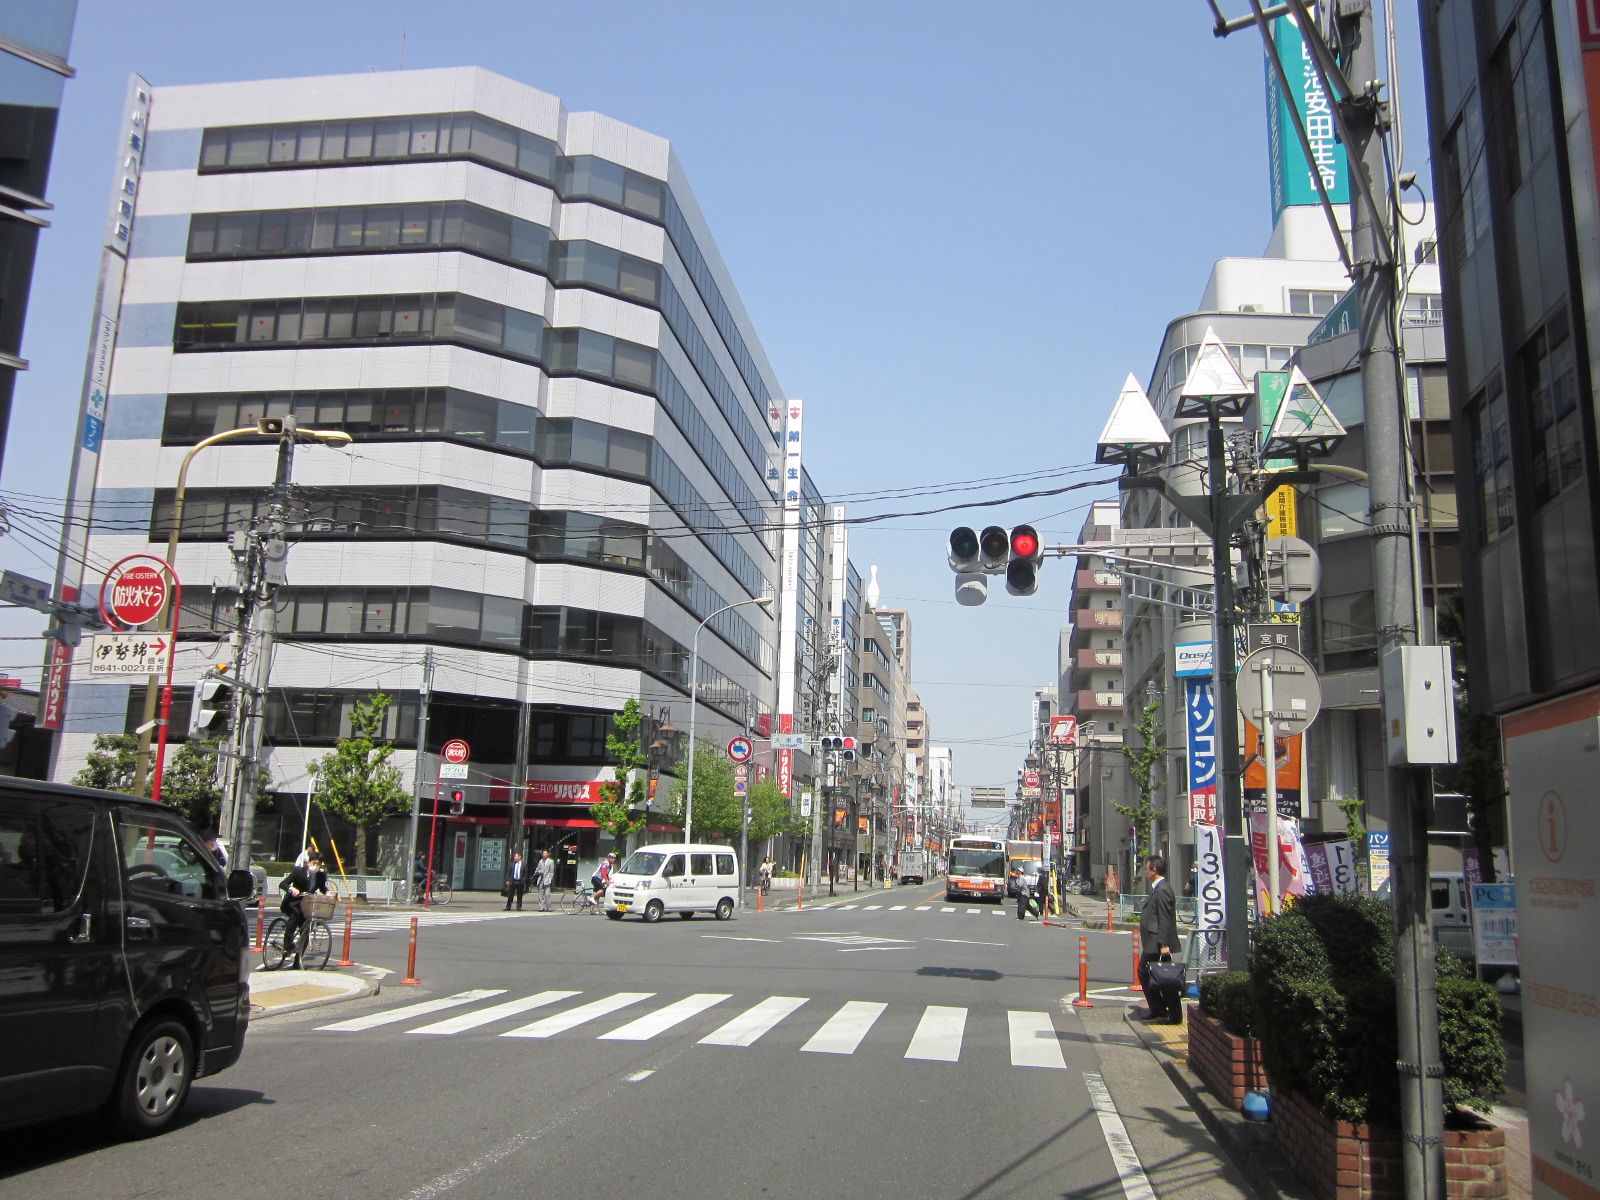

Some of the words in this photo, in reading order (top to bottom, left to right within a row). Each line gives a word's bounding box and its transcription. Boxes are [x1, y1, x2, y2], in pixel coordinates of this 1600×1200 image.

[787, 430, 800, 502] 第一生命
[114, 585, 163, 607] 防火水そう
[1260, 632, 1288, 645] 宮町
[96, 642, 147, 664] 伊勢錦
[100, 664, 145, 672] 641-0023
[48, 646, 64, 721] のリハウス
[533, 783, 590, 799] 三井のリハウス
[1369, 833, 1389, 844] パソ
[1475, 888, 1498, 901] PC
